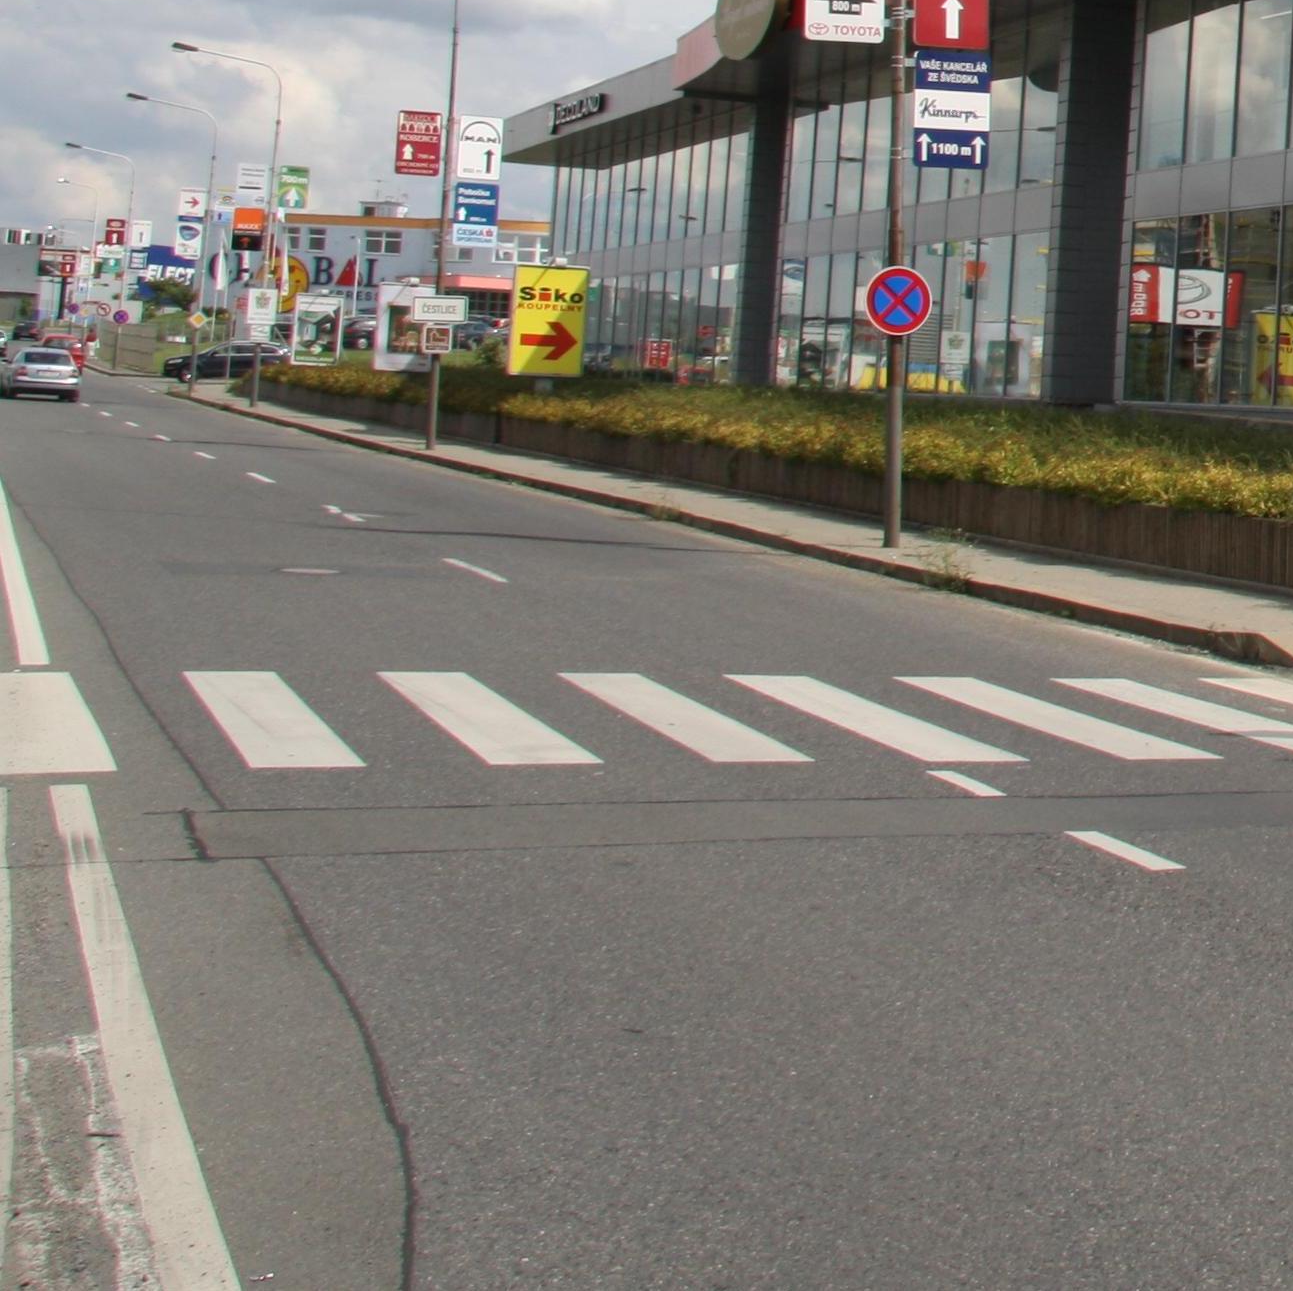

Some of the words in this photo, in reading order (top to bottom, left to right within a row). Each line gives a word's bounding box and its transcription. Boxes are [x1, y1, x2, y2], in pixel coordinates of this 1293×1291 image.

[831, 0, 850, 12] 800
[851, 3, 861, 12] m
[833, 24, 882, 37] TOYOTA
[919, 59, 942, 70] VAŠE
[943, 60, 988, 73] KANCELÁŘ
[927, 72, 939, 82] ZE
[940, 71, 979, 85] ŠVÉDSKA
[931, 142, 958, 155] 1100
[960, 146, 972, 156] m
[518, 286, 584, 304] Siko
[422, 302, 457, 315] ČESTLICE
